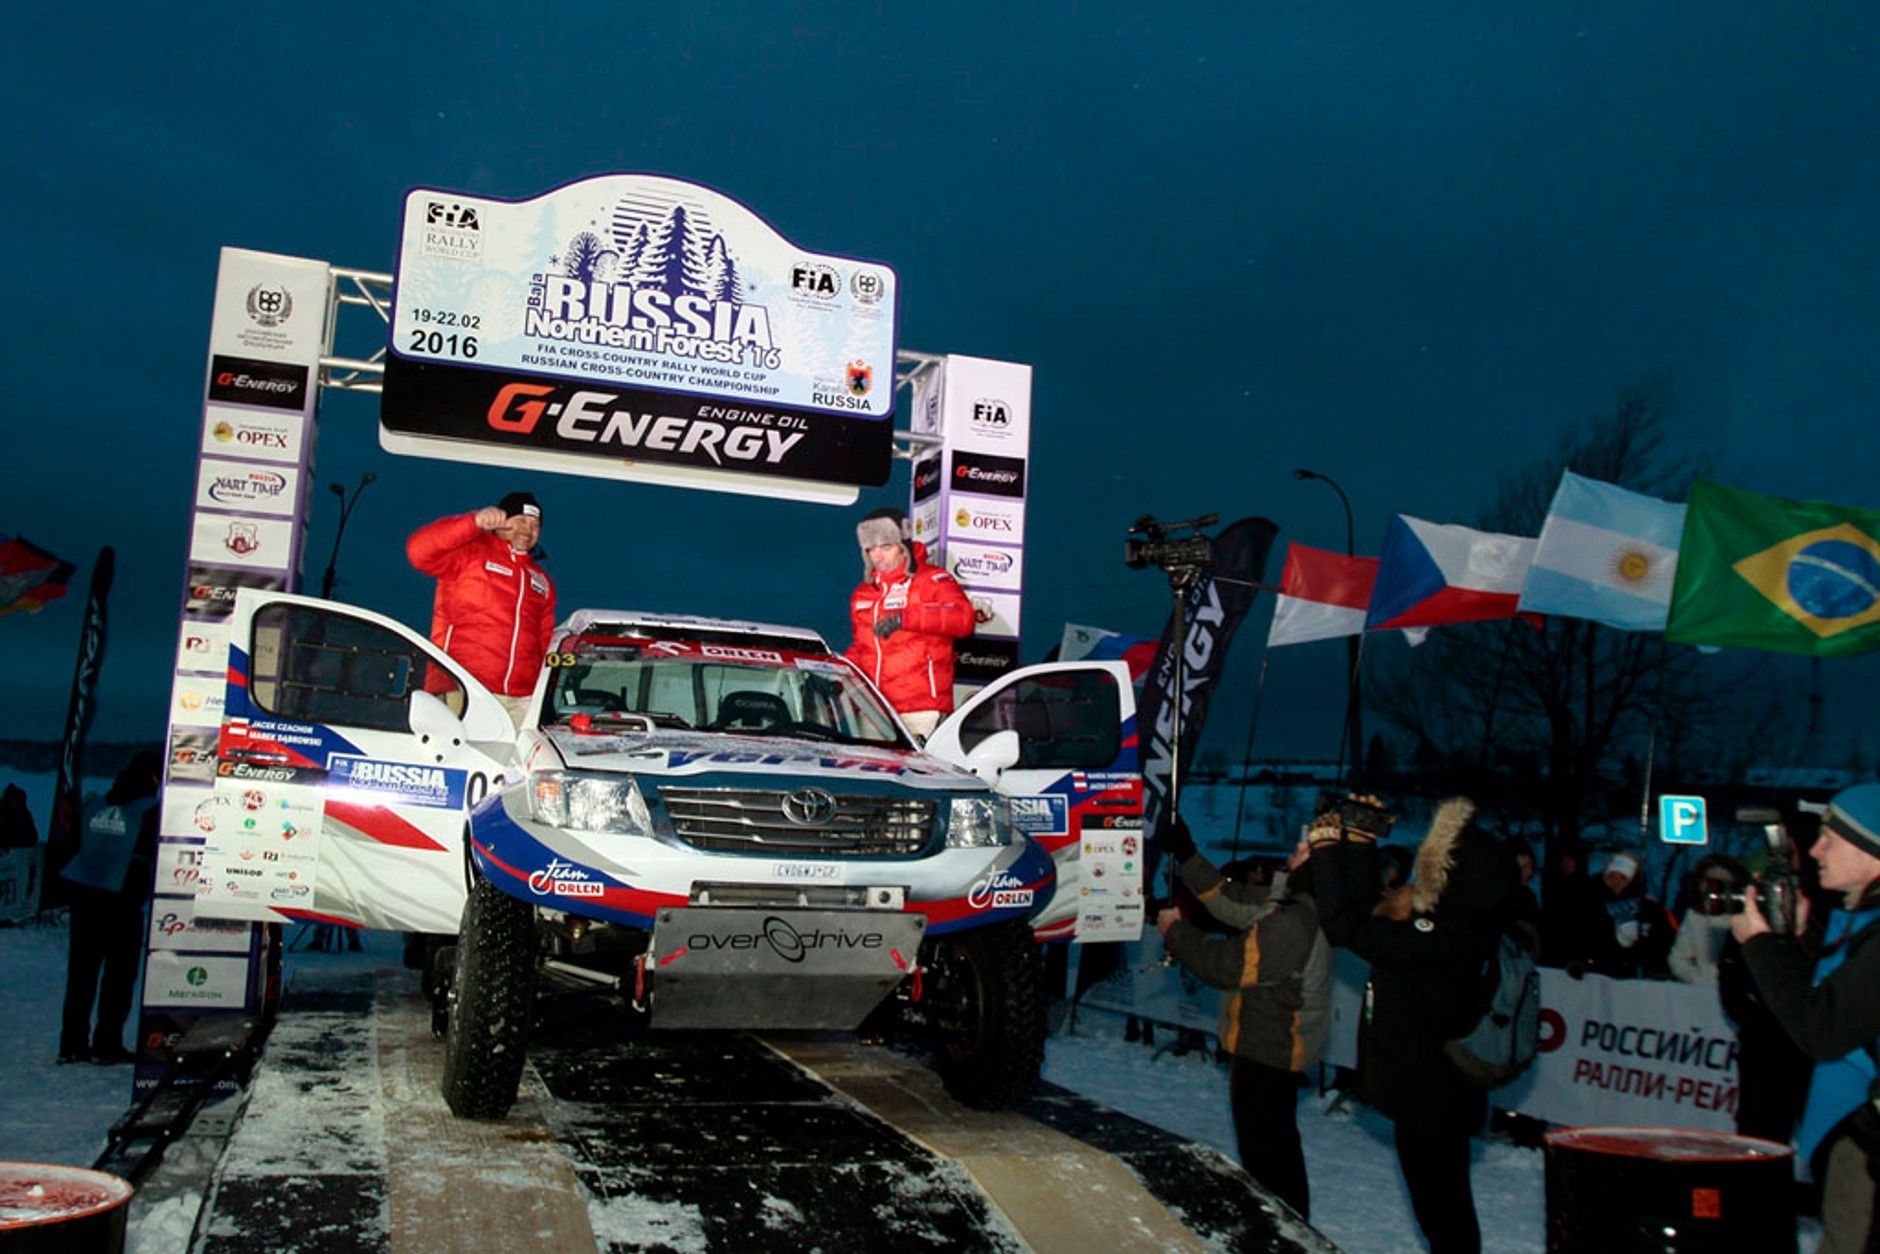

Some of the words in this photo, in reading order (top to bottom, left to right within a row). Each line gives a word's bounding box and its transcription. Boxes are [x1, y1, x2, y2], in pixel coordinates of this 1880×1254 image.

[426, 233, 479, 250] RALLY
[527, 273, 544, 307] Baja
[412, 308, 481, 329] 19-22.02
[544, 274, 773, 352] RUSSIA
[409, 329, 479, 359] 2016
[525, 308, 652, 352] Northern
[655, 325, 744, 364] Forest
[537, 343, 557, 355] FIA
[559, 345, 658, 368] CROSS-COUNTRY
[662, 360, 698, 374] RALLY
[701, 365, 741, 379] WORLD
[743, 371, 767, 382] CUP
[521, 354, 578, 370] RUSSIAN
[580, 361, 686, 384] CROSS-COUNTRY
[688, 376, 780, 396] CHAMPIONSHIP
[812, 392, 872, 411] RUSSIA
[697, 405, 776, 425] ENGINE
[776, 416, 810, 430] OIL
[236, 430, 287, 448] OPEX
[215, 476, 247, 492] NART
[251, 481, 281, 496] TIME
[972, 516, 1012, 532] OPEX
[546, 653, 577, 666] 03
[705, 645, 778, 662] ORLEN
[252, 720, 276, 730] JACEK
[351, 776, 398, 790] Northern
[358, 761, 446, 788] RUSSIA
[1672, 803, 1698, 837] P
[557, 882, 601, 894] ORLEN
[995, 891, 1032, 905] ORLEN
